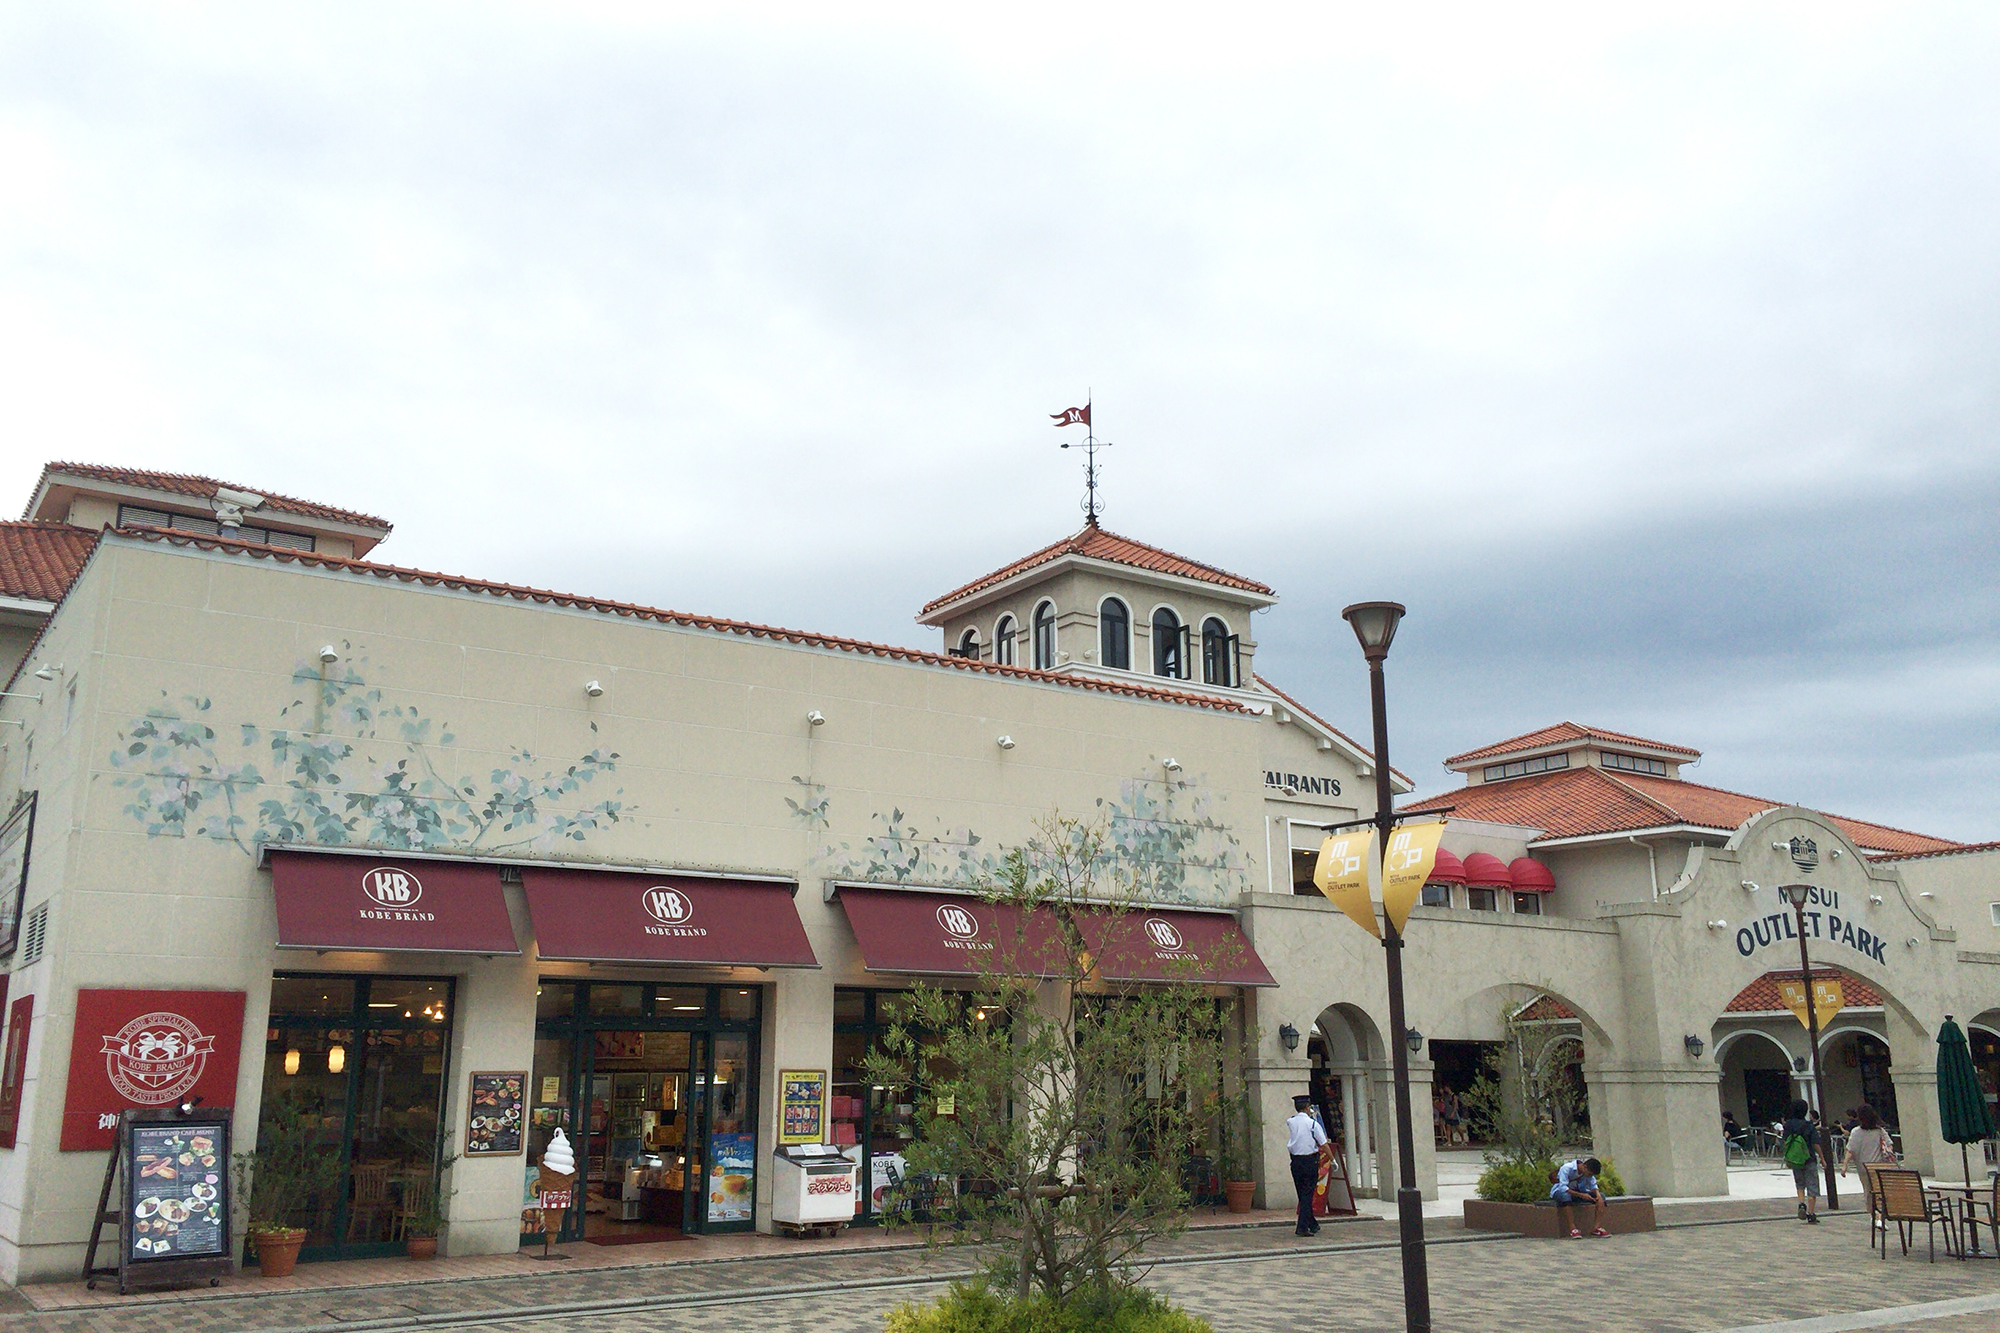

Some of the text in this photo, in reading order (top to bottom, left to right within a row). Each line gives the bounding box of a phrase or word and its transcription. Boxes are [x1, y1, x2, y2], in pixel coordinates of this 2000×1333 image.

[1067, 410, 1083, 422] M
[1262, 770, 1342, 797] AURANTS
[374, 872, 410, 902] KB
[1327, 883, 1346, 891] OUTLET
[1389, 876, 1407, 884] OUTLET
[651, 891, 683, 918] KB
[1778, 886, 1839, 909] MSUI
[359, 909, 391, 920] KOBE
[395, 912, 435, 922] BRAND
[942, 909, 971, 933] KB
[644, 926, 671, 936] KOBE
[673, 928, 707, 937] BRAND
[1736, 911, 1887, 966] OUTLET PARK
[124, 1018, 147, 1037] KOBE
[129, 1060, 186, 1072] KOBE BRAND
[113, 1074, 131, 1094] GOOD
[132, 1090, 156, 1101] TASTE
[159, 1085, 182, 1100] FROM
[808, 1181, 852, 1194] アイスクリーム
